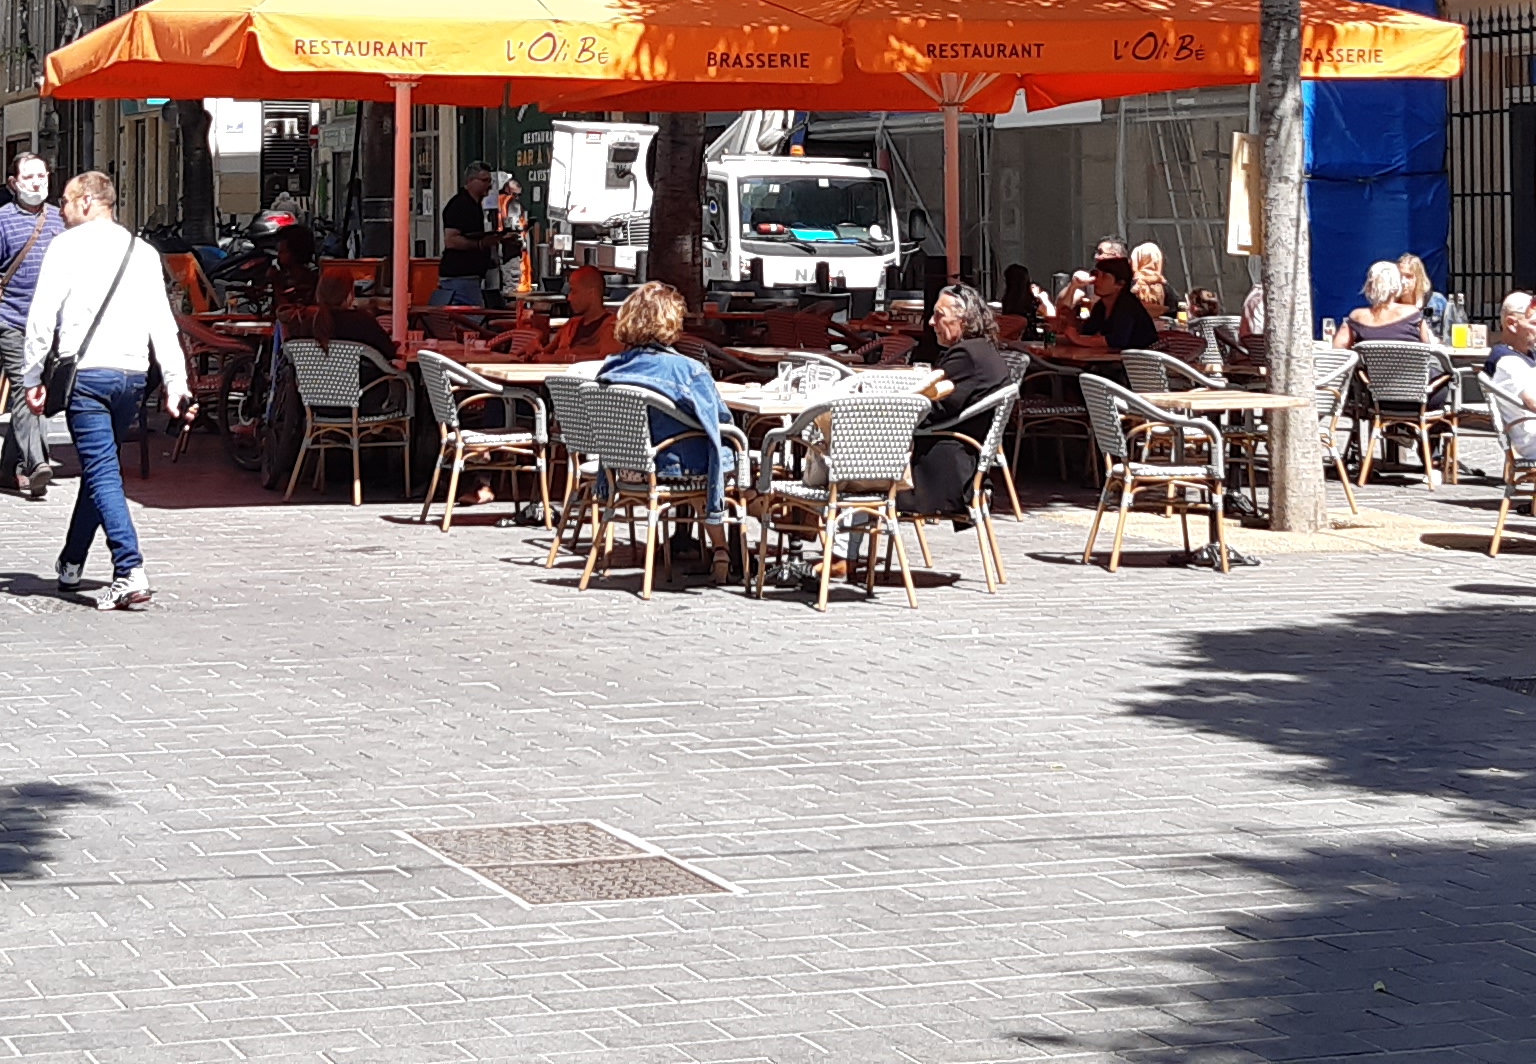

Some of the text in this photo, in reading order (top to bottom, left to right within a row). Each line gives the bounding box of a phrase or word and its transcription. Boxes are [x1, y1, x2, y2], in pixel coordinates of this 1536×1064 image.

[294, 39, 428, 58] RESTAURANT
[926, 43, 1045, 59] RESTAURANT
[1302, 47, 1384, 64] RASSERIE
[707, 51, 810, 69] BRASSERIE
[523, 130, 553, 145] RESTAURA
